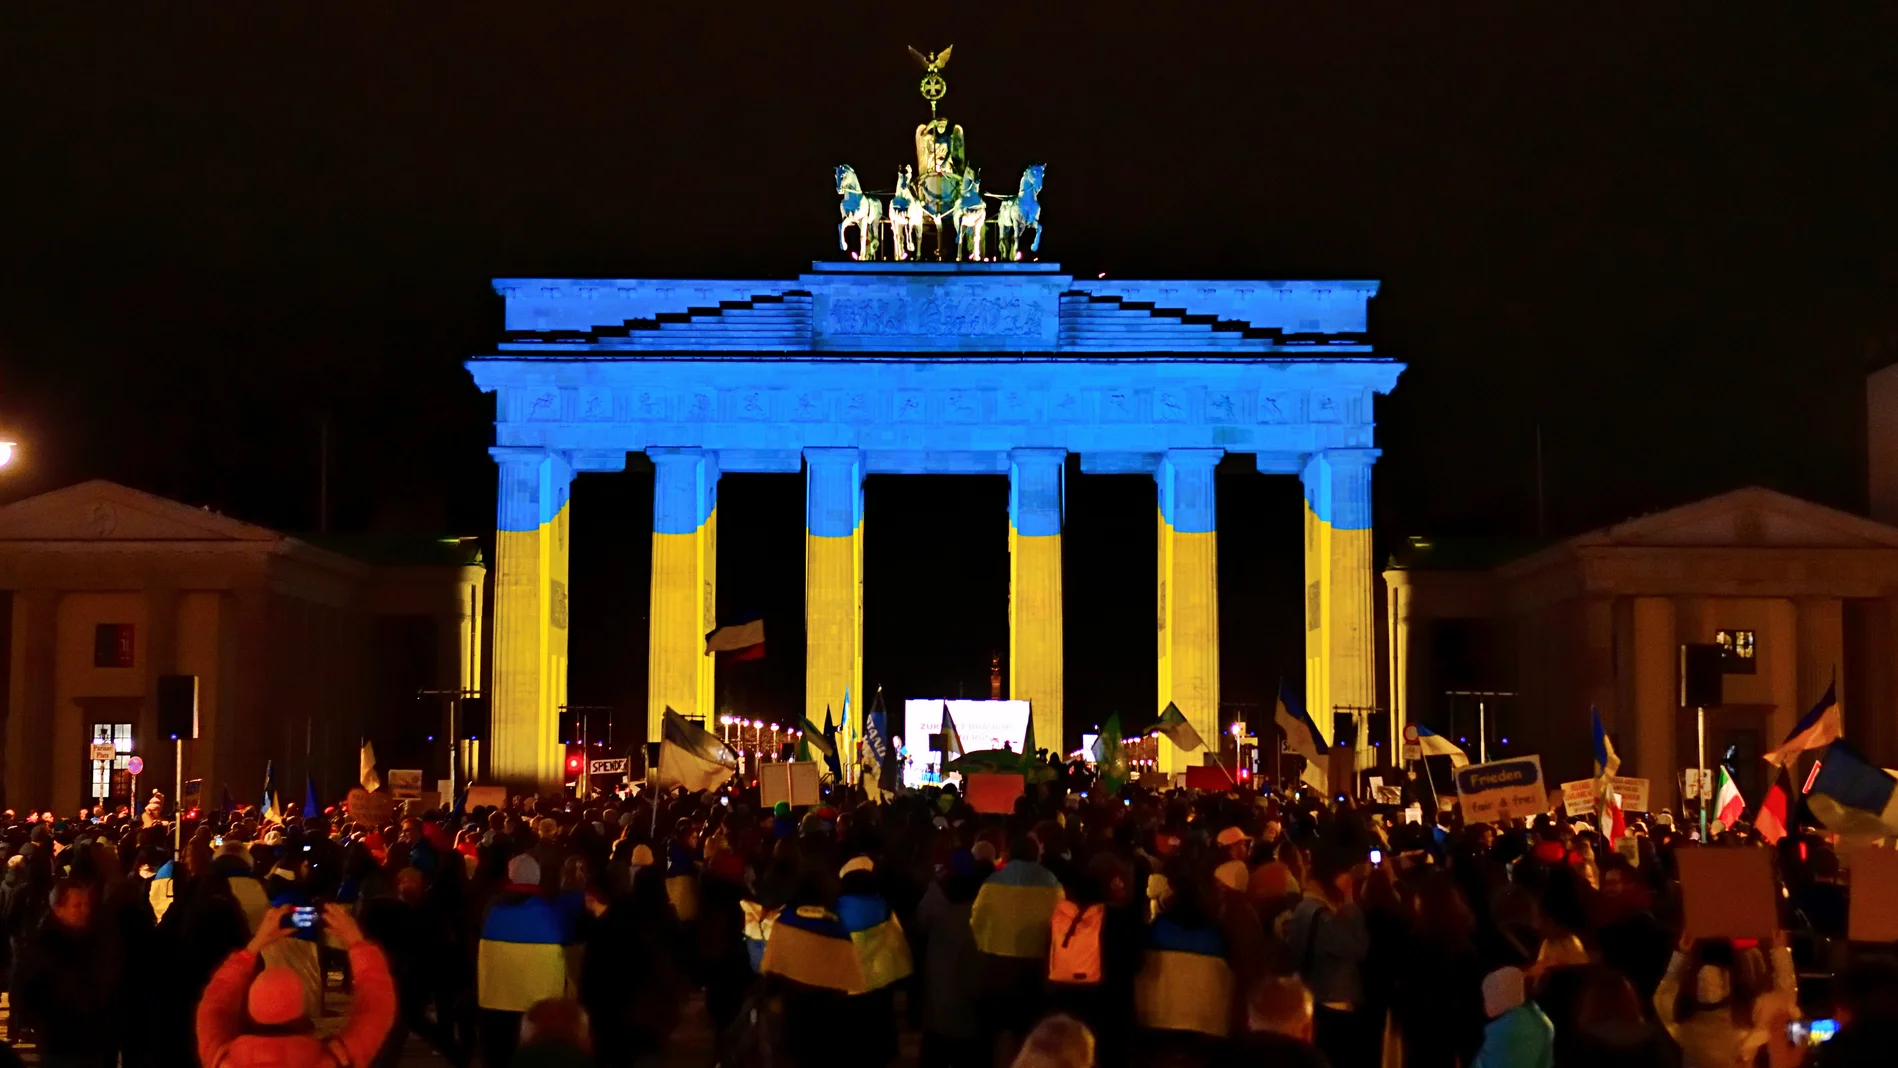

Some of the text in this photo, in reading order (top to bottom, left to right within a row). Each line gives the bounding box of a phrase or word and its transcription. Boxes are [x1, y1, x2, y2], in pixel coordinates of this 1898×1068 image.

[920, 722, 968, 730] ZUKT
[1470, 769, 1523, 789] Frieden
[1472, 800, 1494, 813] fair
[1513, 794, 1537, 806] frei
